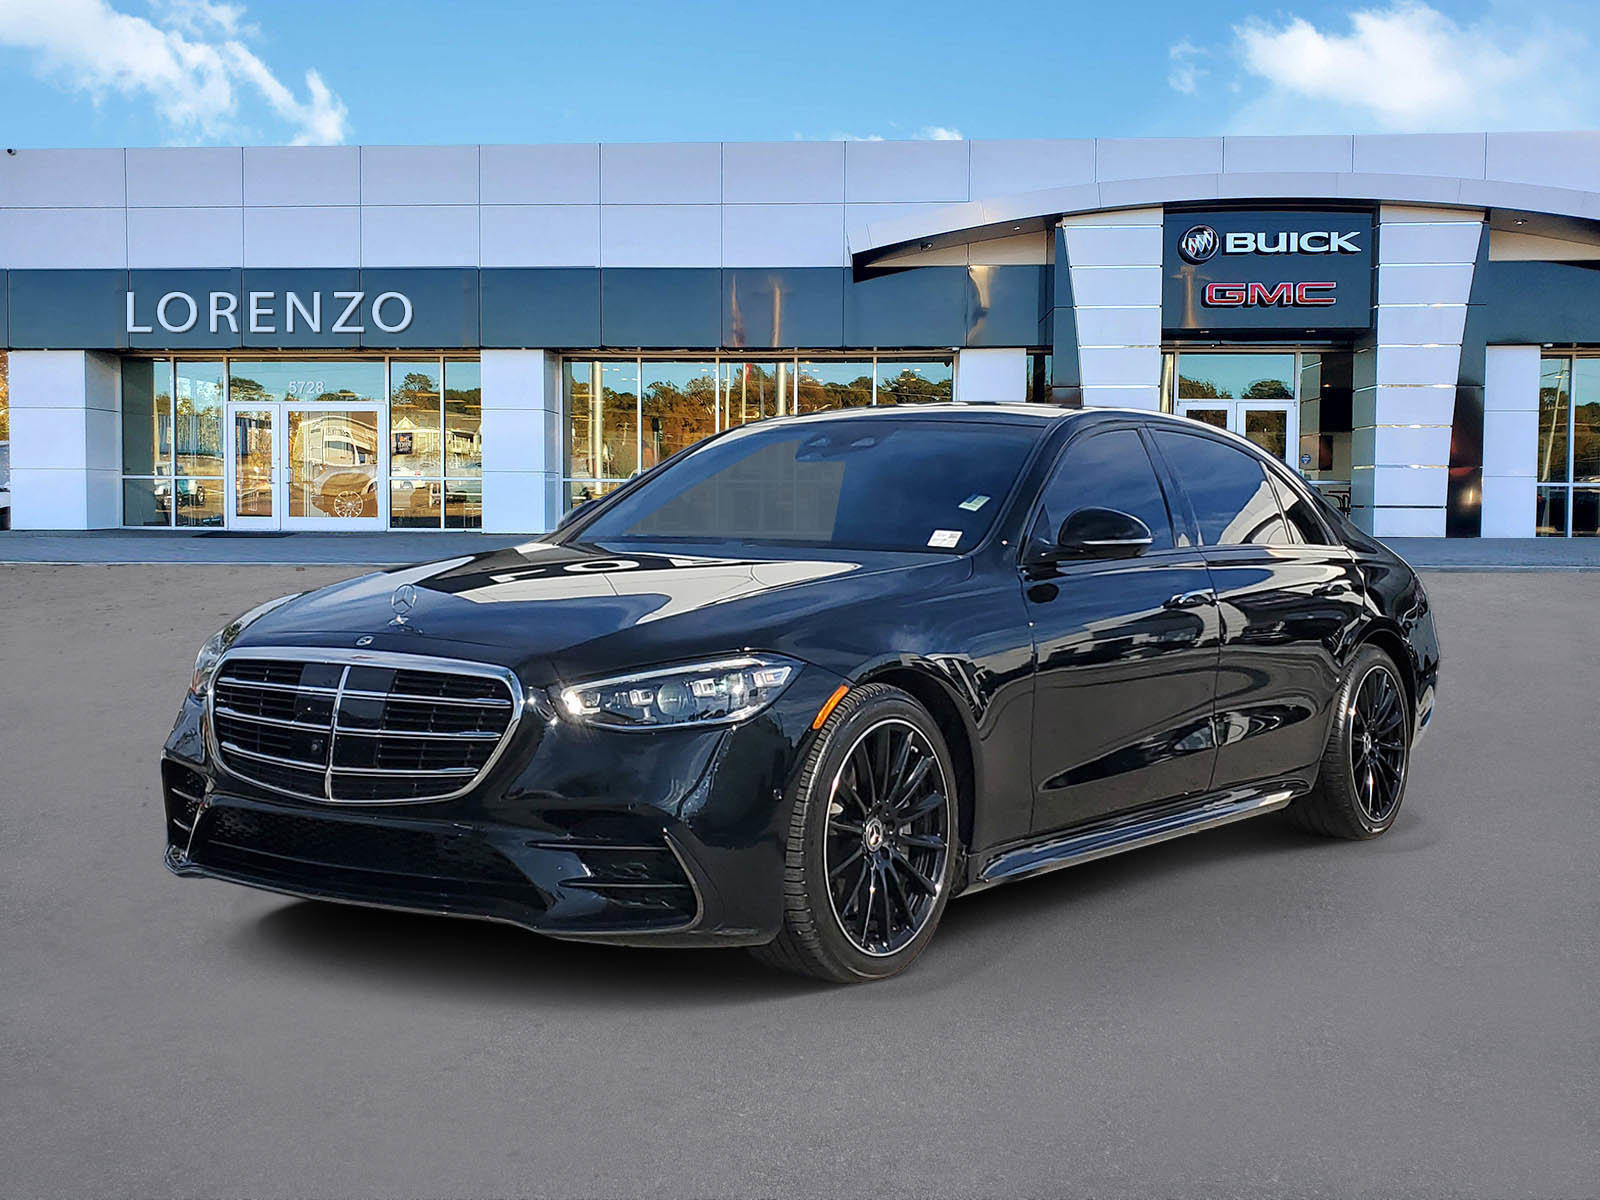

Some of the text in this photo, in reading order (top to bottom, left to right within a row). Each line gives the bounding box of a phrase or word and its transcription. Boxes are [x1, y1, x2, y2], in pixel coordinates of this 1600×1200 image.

[1225, 231, 1362, 253] BUICK
[1206, 282, 1337, 305] GMC
[126, 291, 414, 333] LORENZO
[288, 380, 325, 394] 5728
